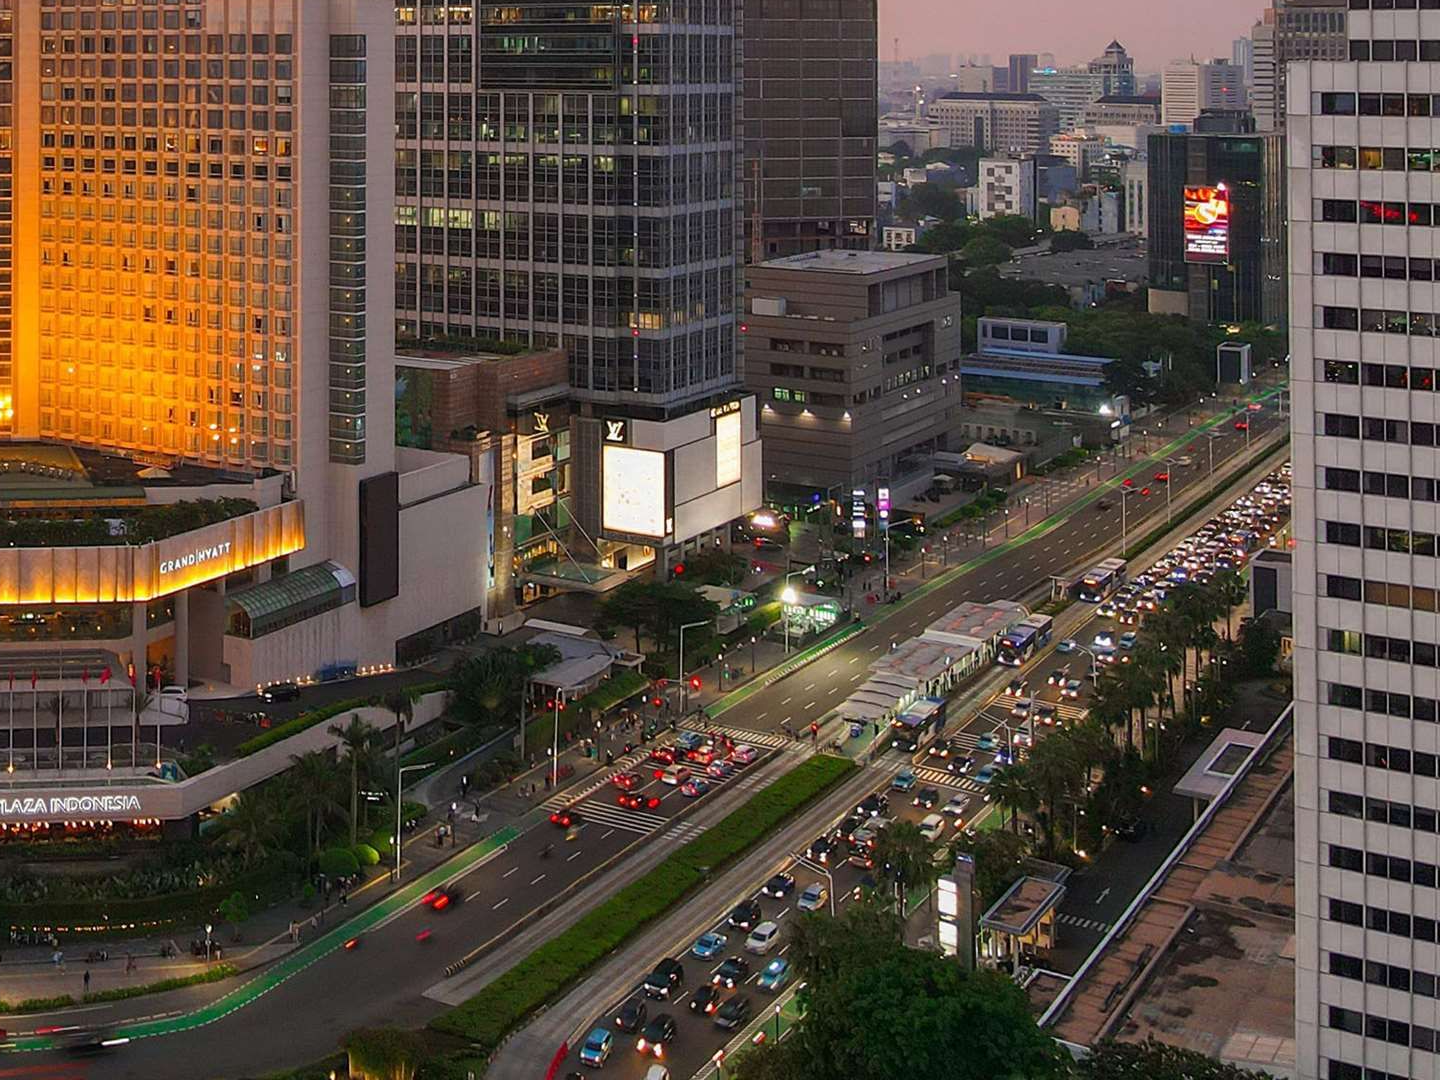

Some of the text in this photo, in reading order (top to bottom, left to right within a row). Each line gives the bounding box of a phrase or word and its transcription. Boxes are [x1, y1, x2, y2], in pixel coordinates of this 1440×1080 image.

[160, 542, 231, 574] GRAND HYATT
[50, 795, 141, 813] INDONESIA
